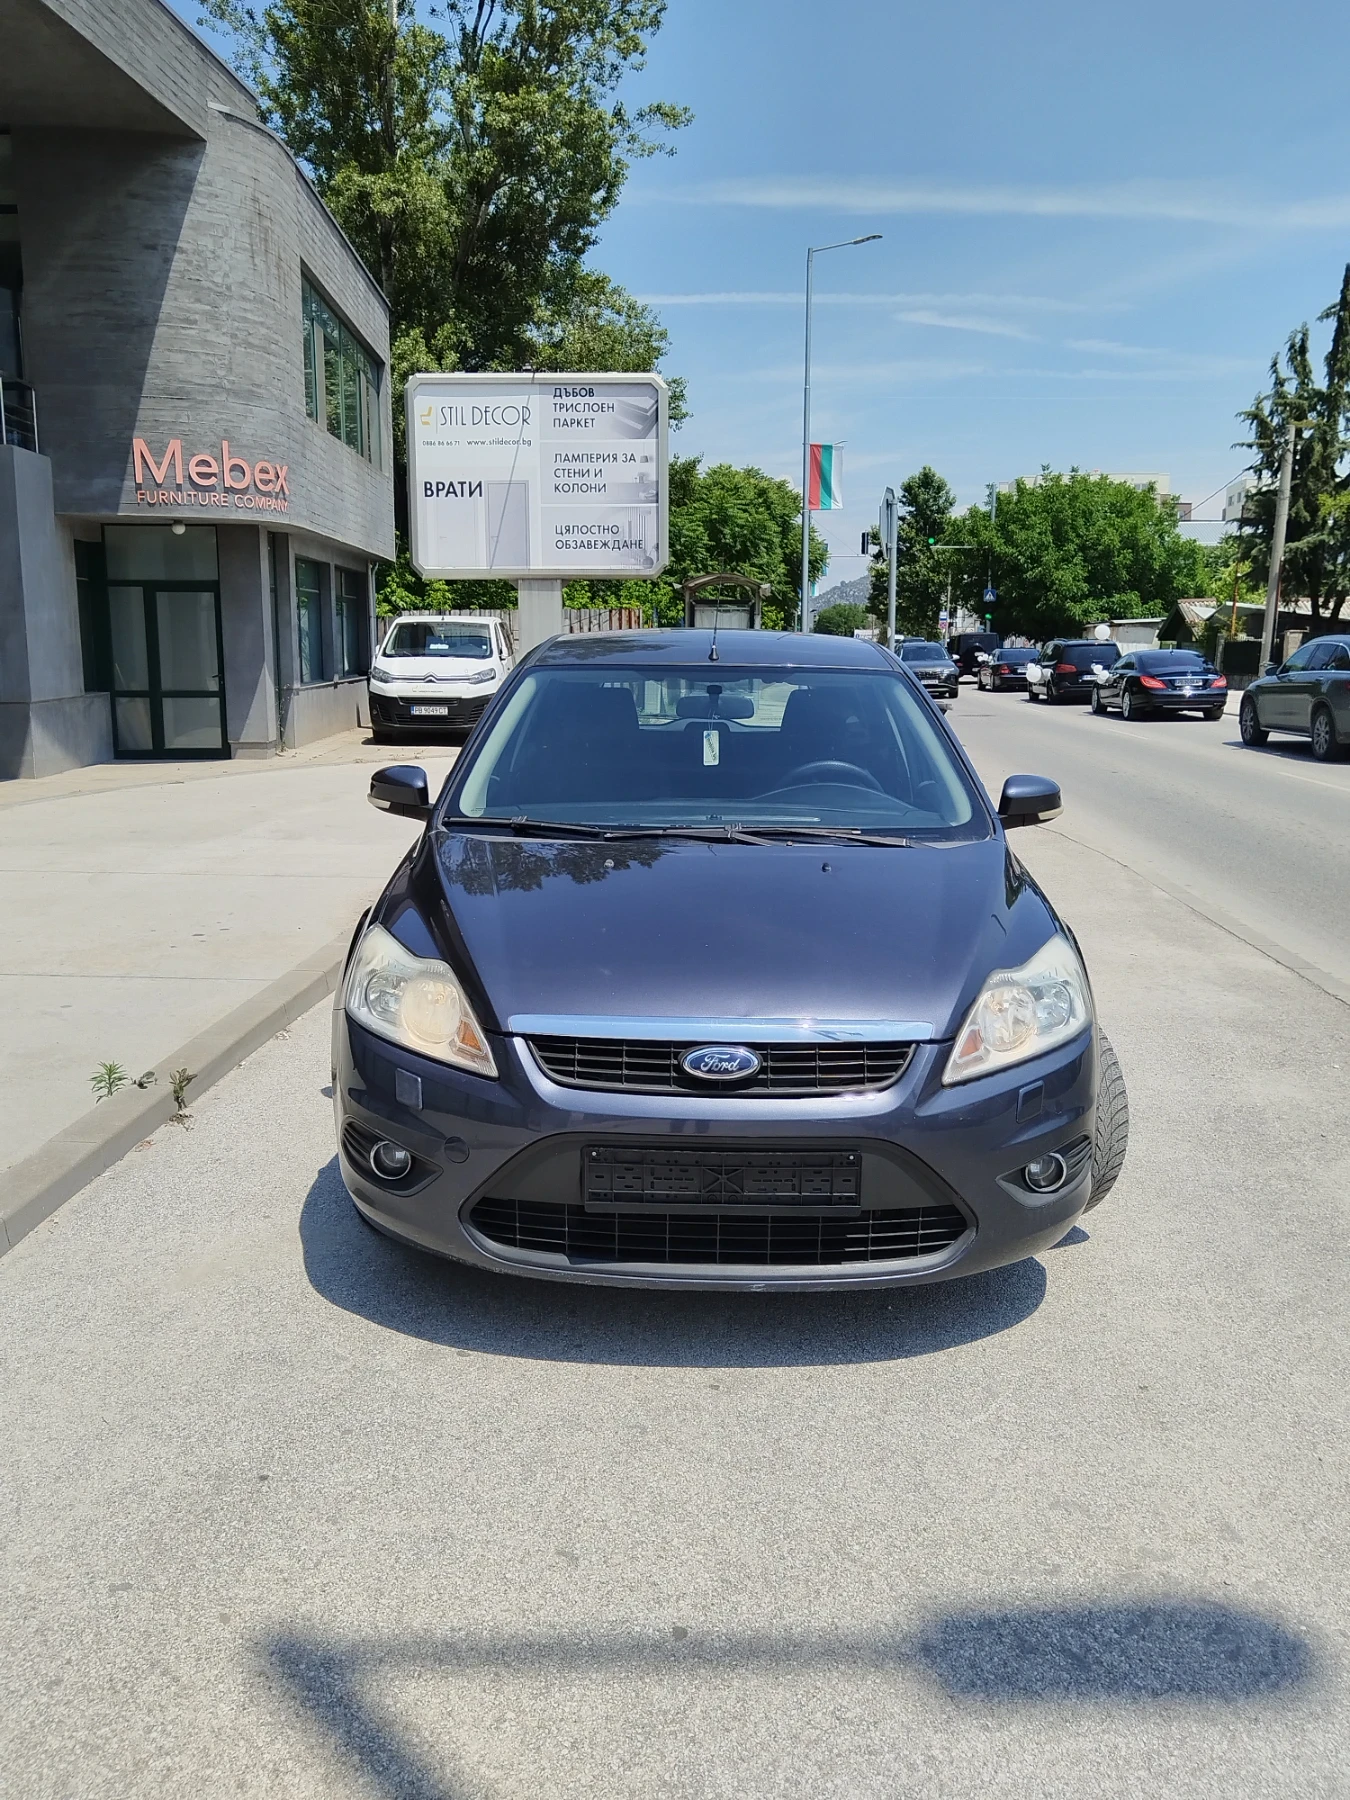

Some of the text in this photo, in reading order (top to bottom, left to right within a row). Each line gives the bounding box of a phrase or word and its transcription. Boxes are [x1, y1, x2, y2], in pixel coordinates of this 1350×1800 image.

[552, 387, 595, 399] ДЪБОВ
[552, 402, 615, 413] ТРИСЛОЕН
[440, 405, 531, 426] STIL DECOR
[552, 417, 595, 428] ПАРКЕТ
[466, 437, 532, 447] www.stildecor.bg
[553, 453, 637, 464] ЛАМПЕРИЯ ЗА
[132, 438, 290, 495] Mebex
[553, 468, 603, 479] СТЕНИ И
[423, 481, 483, 498] ВРАТИ
[553, 482, 607, 493] КОЛОНИ
[137, 490, 289, 512] FURNITURE COMPANY
[554, 524, 620, 536] ЦЯЛОСТНО
[554, 539, 644, 551] ОБЗАВЕЖДАНЕ
[700, 1053, 741, 1072] Ford
